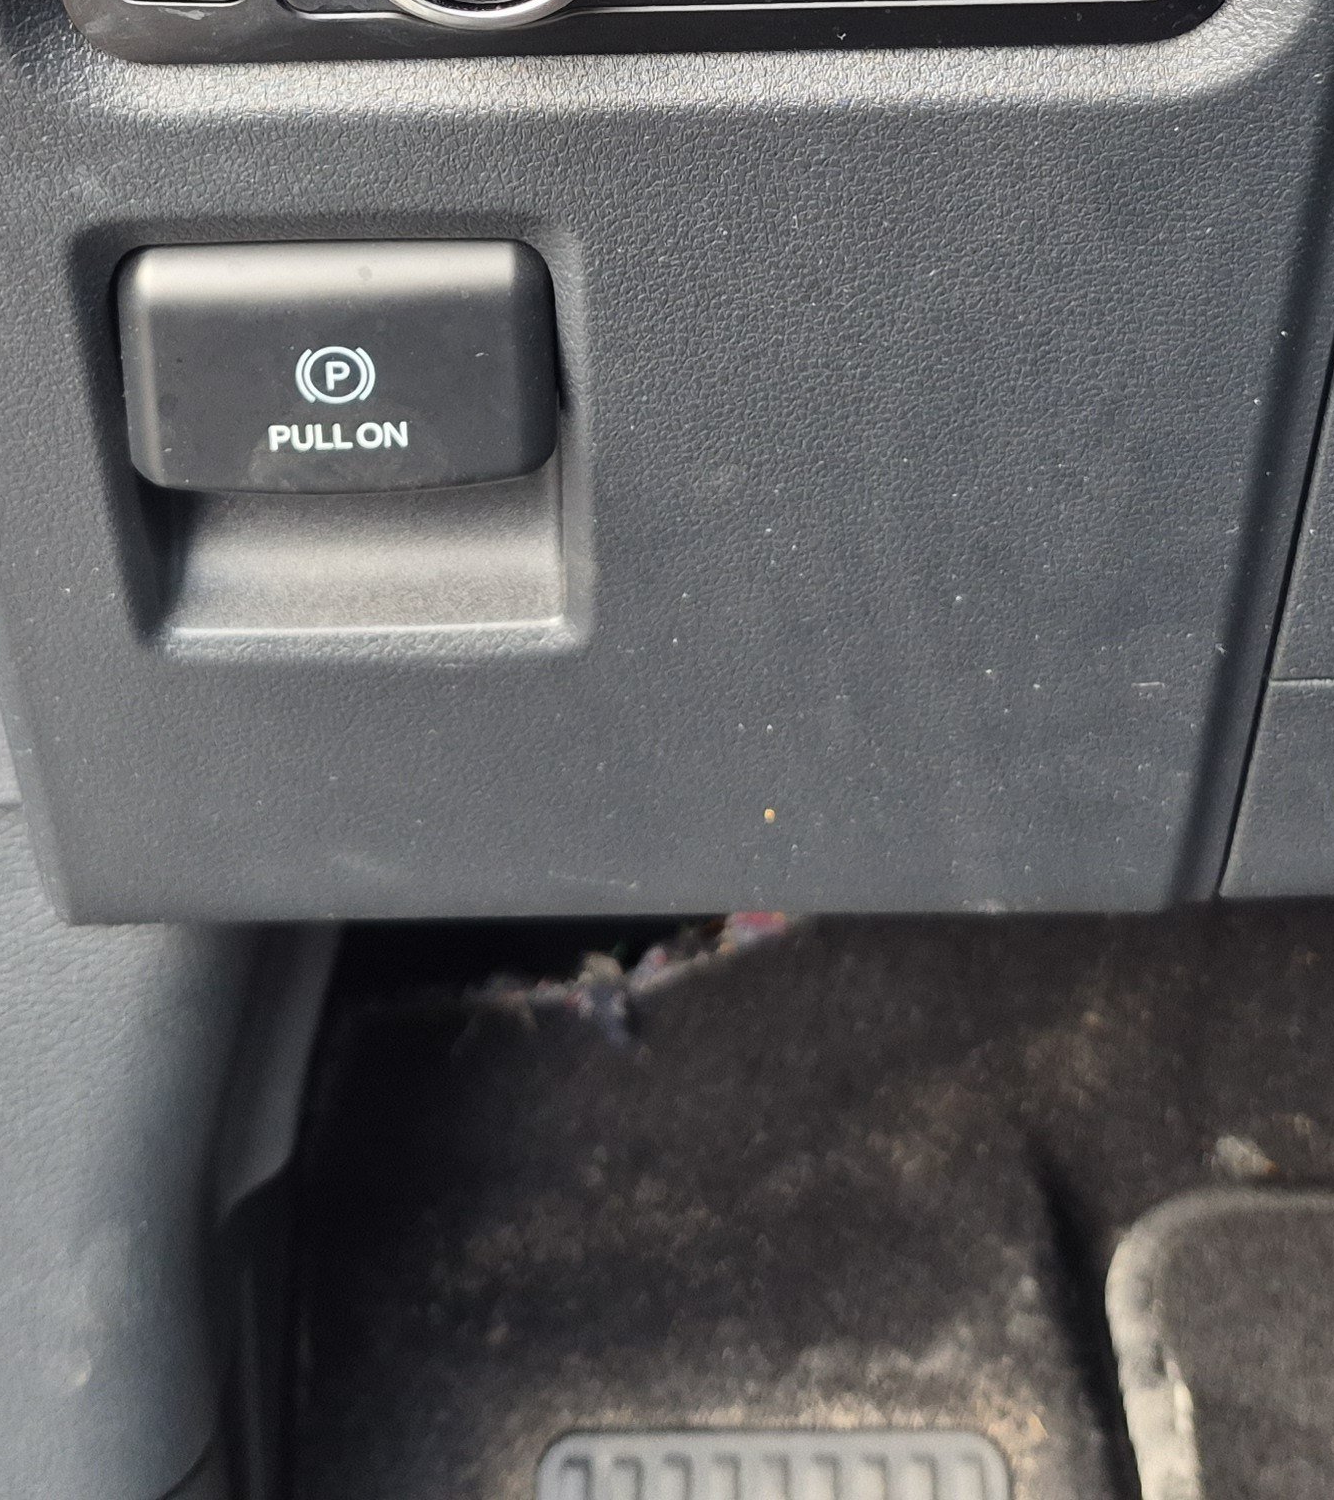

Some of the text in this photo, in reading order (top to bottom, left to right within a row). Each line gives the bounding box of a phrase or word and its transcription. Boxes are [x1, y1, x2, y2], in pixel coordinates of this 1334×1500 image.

[325, 360, 351, 391] P
[268, 421, 409, 452] PULL ON
